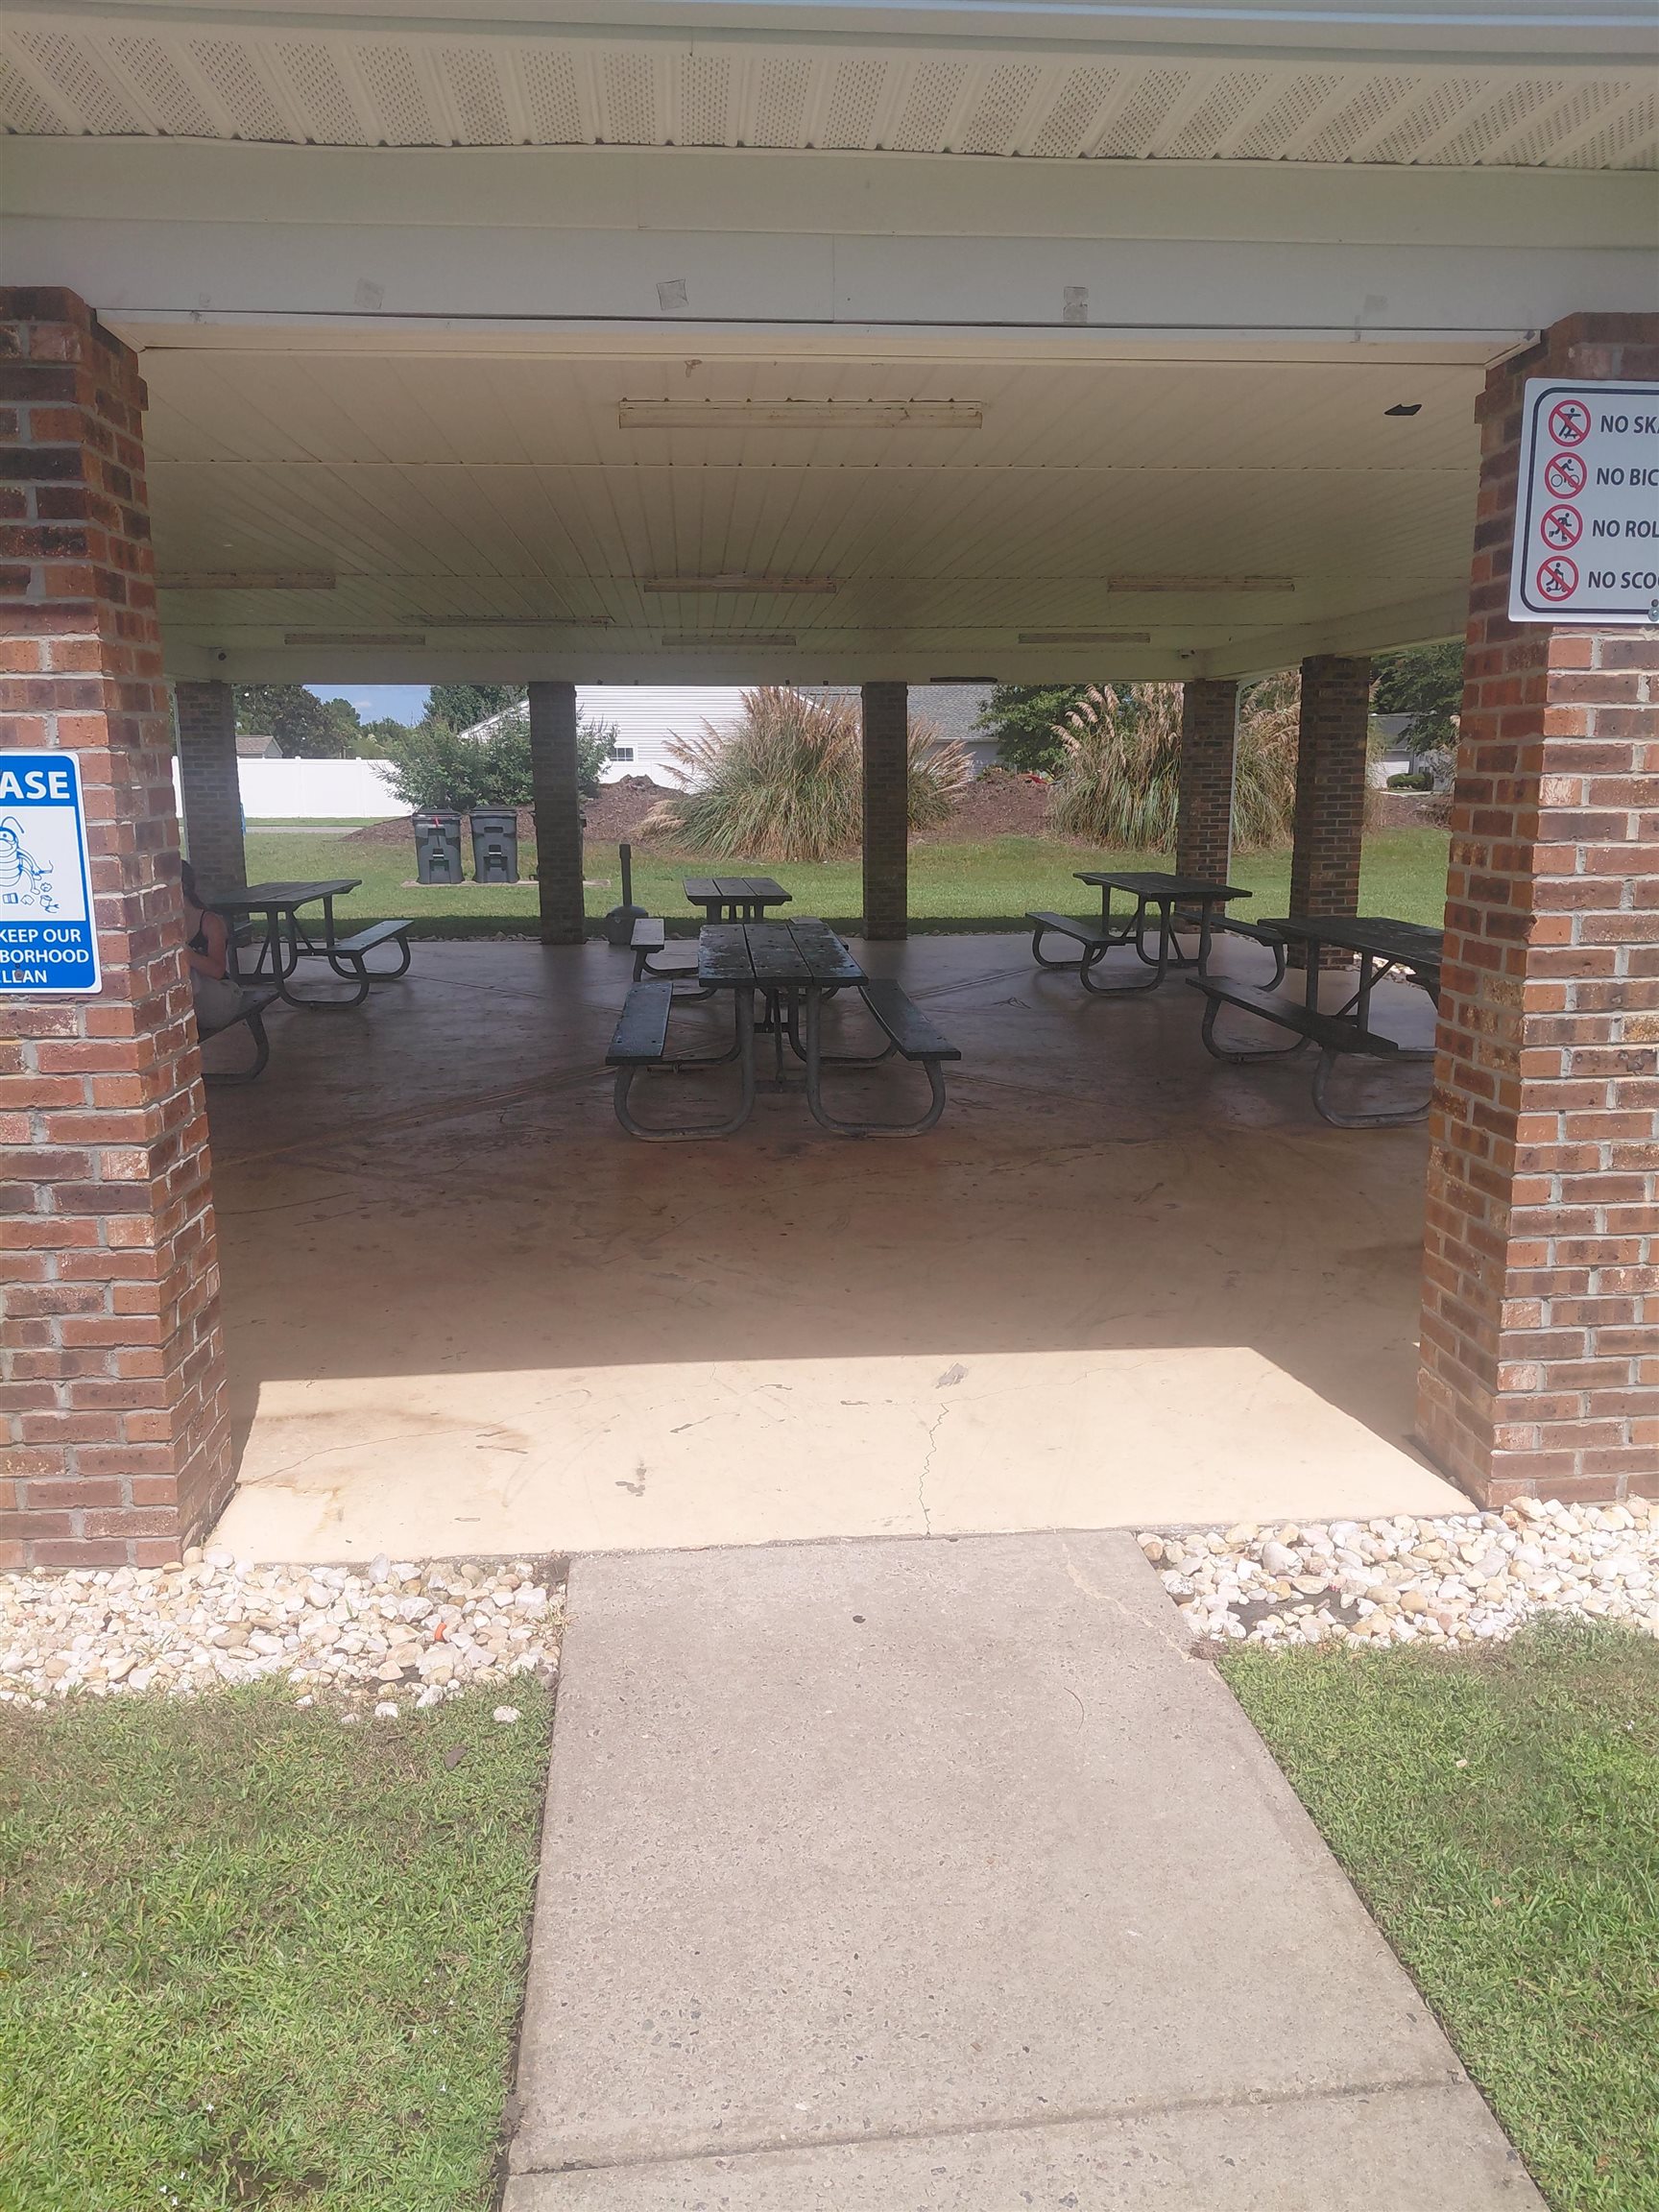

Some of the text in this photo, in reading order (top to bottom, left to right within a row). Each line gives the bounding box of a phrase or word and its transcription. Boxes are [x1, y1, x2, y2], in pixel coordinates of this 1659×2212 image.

[1600, 415, 1659, 434] NO SK
[1597, 468, 1624, 486] NO
[1592, 519, 1621, 538] NO
[1588, 571, 1659, 589] NO SCO
[42, 928, 82, 943] OUR
